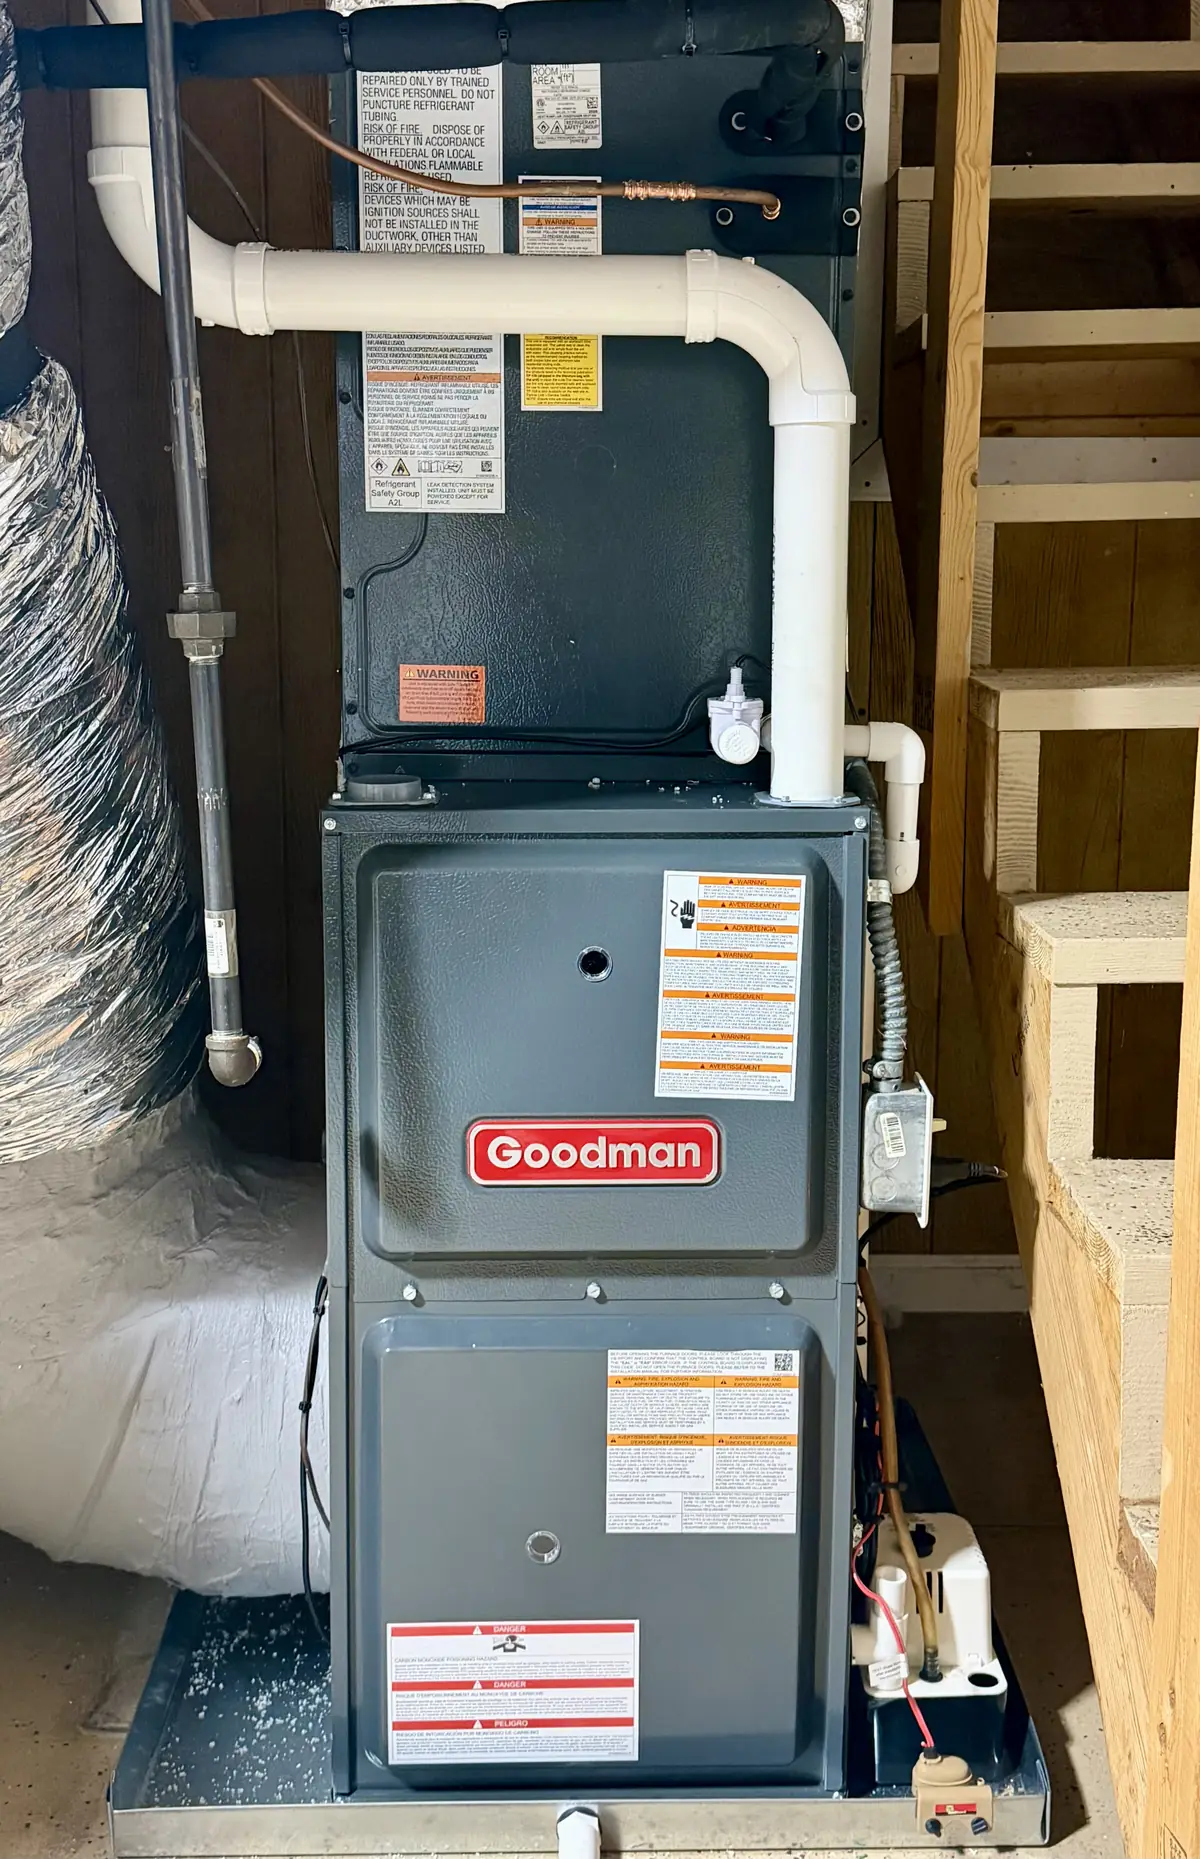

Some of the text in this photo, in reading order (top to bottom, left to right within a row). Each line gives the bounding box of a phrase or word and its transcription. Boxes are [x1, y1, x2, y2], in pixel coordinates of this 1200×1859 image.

[533, 68, 558, 76] ROOM
[362, 76, 489, 87] REPAIRED ONLY BY TRAINED
[362, 88, 400, 98] SERVICE
[461, 89, 474, 99] DO
[477, 90, 495, 99] NOT
[362, 100, 474, 111] PUNCTURE REFRIGERANT
[362, 112, 398, 121] TUBING.
[364, 124, 485, 135] RISK OF FIRE. DISPOSE OF
[364, 136, 485, 147] PROPERLY IN ACCORDANCE
[364, 148, 476, 158] WITH FEDERAL OR LOCAL
[428, 160, 483, 171] FLAMMABLE
[364, 183, 384, 192] RISK
[386, 183, 399, 192] OF
[364, 195, 470, 206] DEVICES WHICH MAY BE
[365, 207, 480, 218] IGNITION SOURCES SHALL
[365, 219, 479, 230] NOT BE INSTALLED IN THE
[365, 231, 478, 242] DUCTWORK, OTHER THAN
[366, 243, 485, 253] AUXILIARY DEVICES LISTED
[375, 480, 416, 488] Refrigerant
[397, 490, 420, 498] Group
[417, 669, 478, 679] WARNING
[487, 1135, 700, 1169] Goodman
[493, 1625, 526, 1633] DANGER
